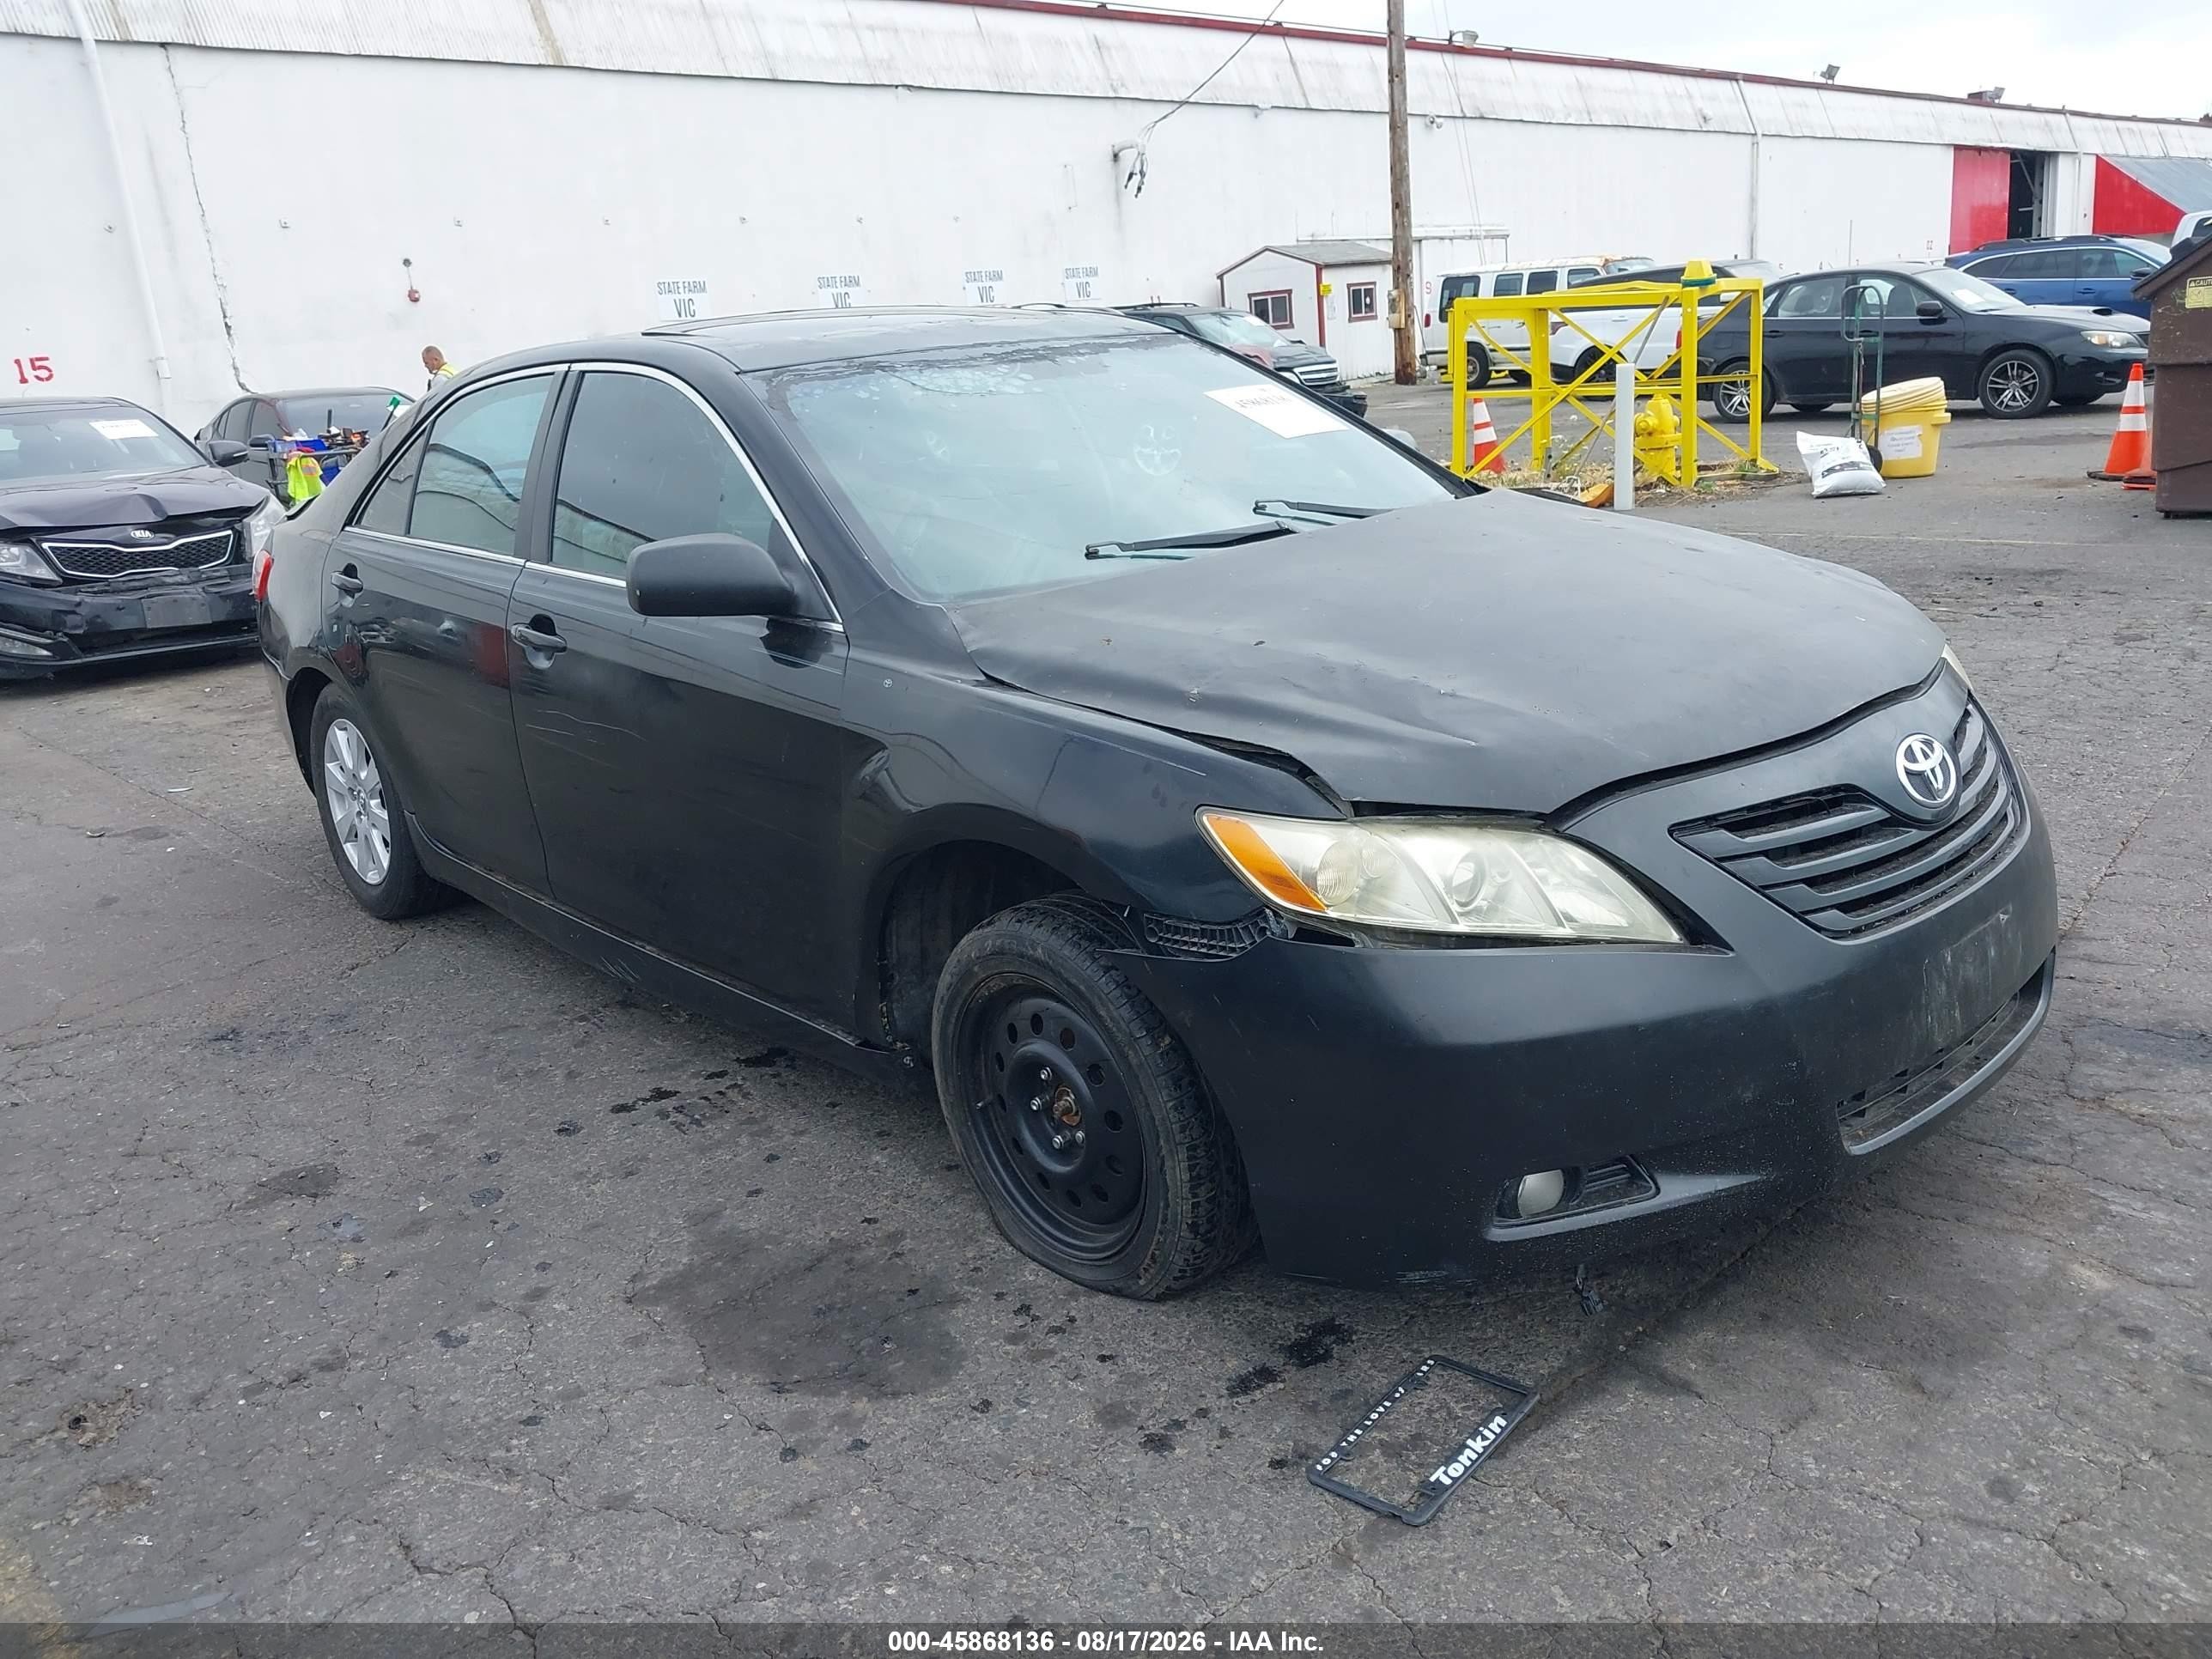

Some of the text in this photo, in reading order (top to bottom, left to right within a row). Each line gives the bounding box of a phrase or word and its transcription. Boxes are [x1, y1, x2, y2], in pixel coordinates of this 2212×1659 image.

[964, 270, 1003, 283] STATE FARM
[1065, 266, 1098, 280] STATE FARM
[657, 280, 708, 295] STATE FARM
[817, 275, 861, 289] STATE FARM
[1075, 282, 1091, 298] VIC
[831, 292, 851, 308] VIC
[977, 286, 994, 303] VIC
[673, 298, 696, 318] VIC
[14, 356, 54, 384] 15
[132, 529, 153, 538] KIA
[1364, 1401, 1392, 1425] LOVE
[1428, 1415, 1508, 1486] Tonkin
